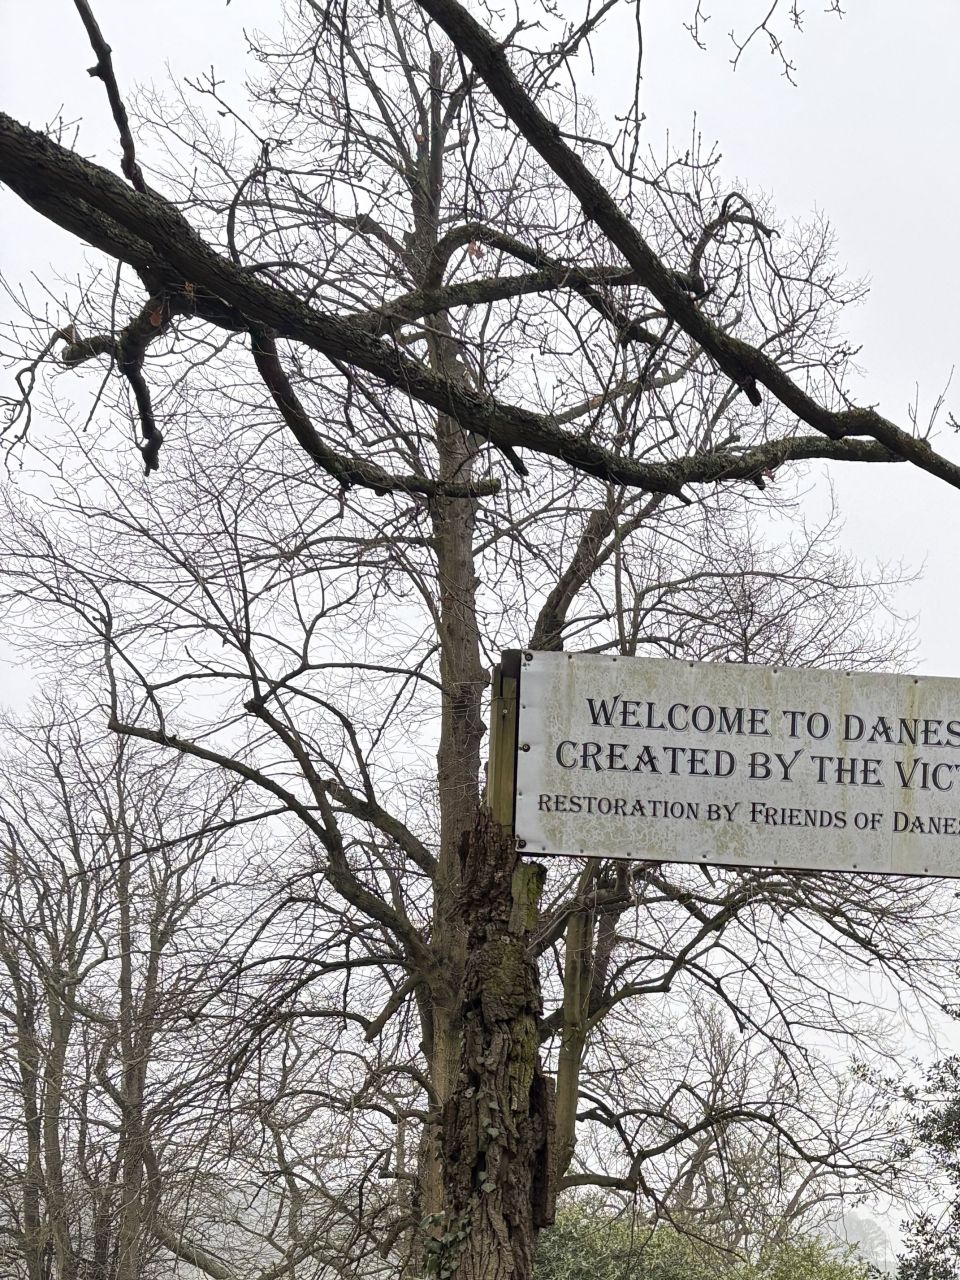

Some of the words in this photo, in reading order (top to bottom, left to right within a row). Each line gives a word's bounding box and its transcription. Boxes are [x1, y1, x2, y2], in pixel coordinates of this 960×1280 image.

[586, 694, 772, 737] WELCOME
[782, 709, 831, 740] TO
[555, 740, 737, 779] CREATED
[748, 748, 805, 783] BY
[810, 755, 885, 788] THE
[537, 793, 699, 821] RESTORATION
[706, 801, 742, 823] BY
[749, 802, 848, 830] FRIENDS
[854, 811, 883, 832] OF
